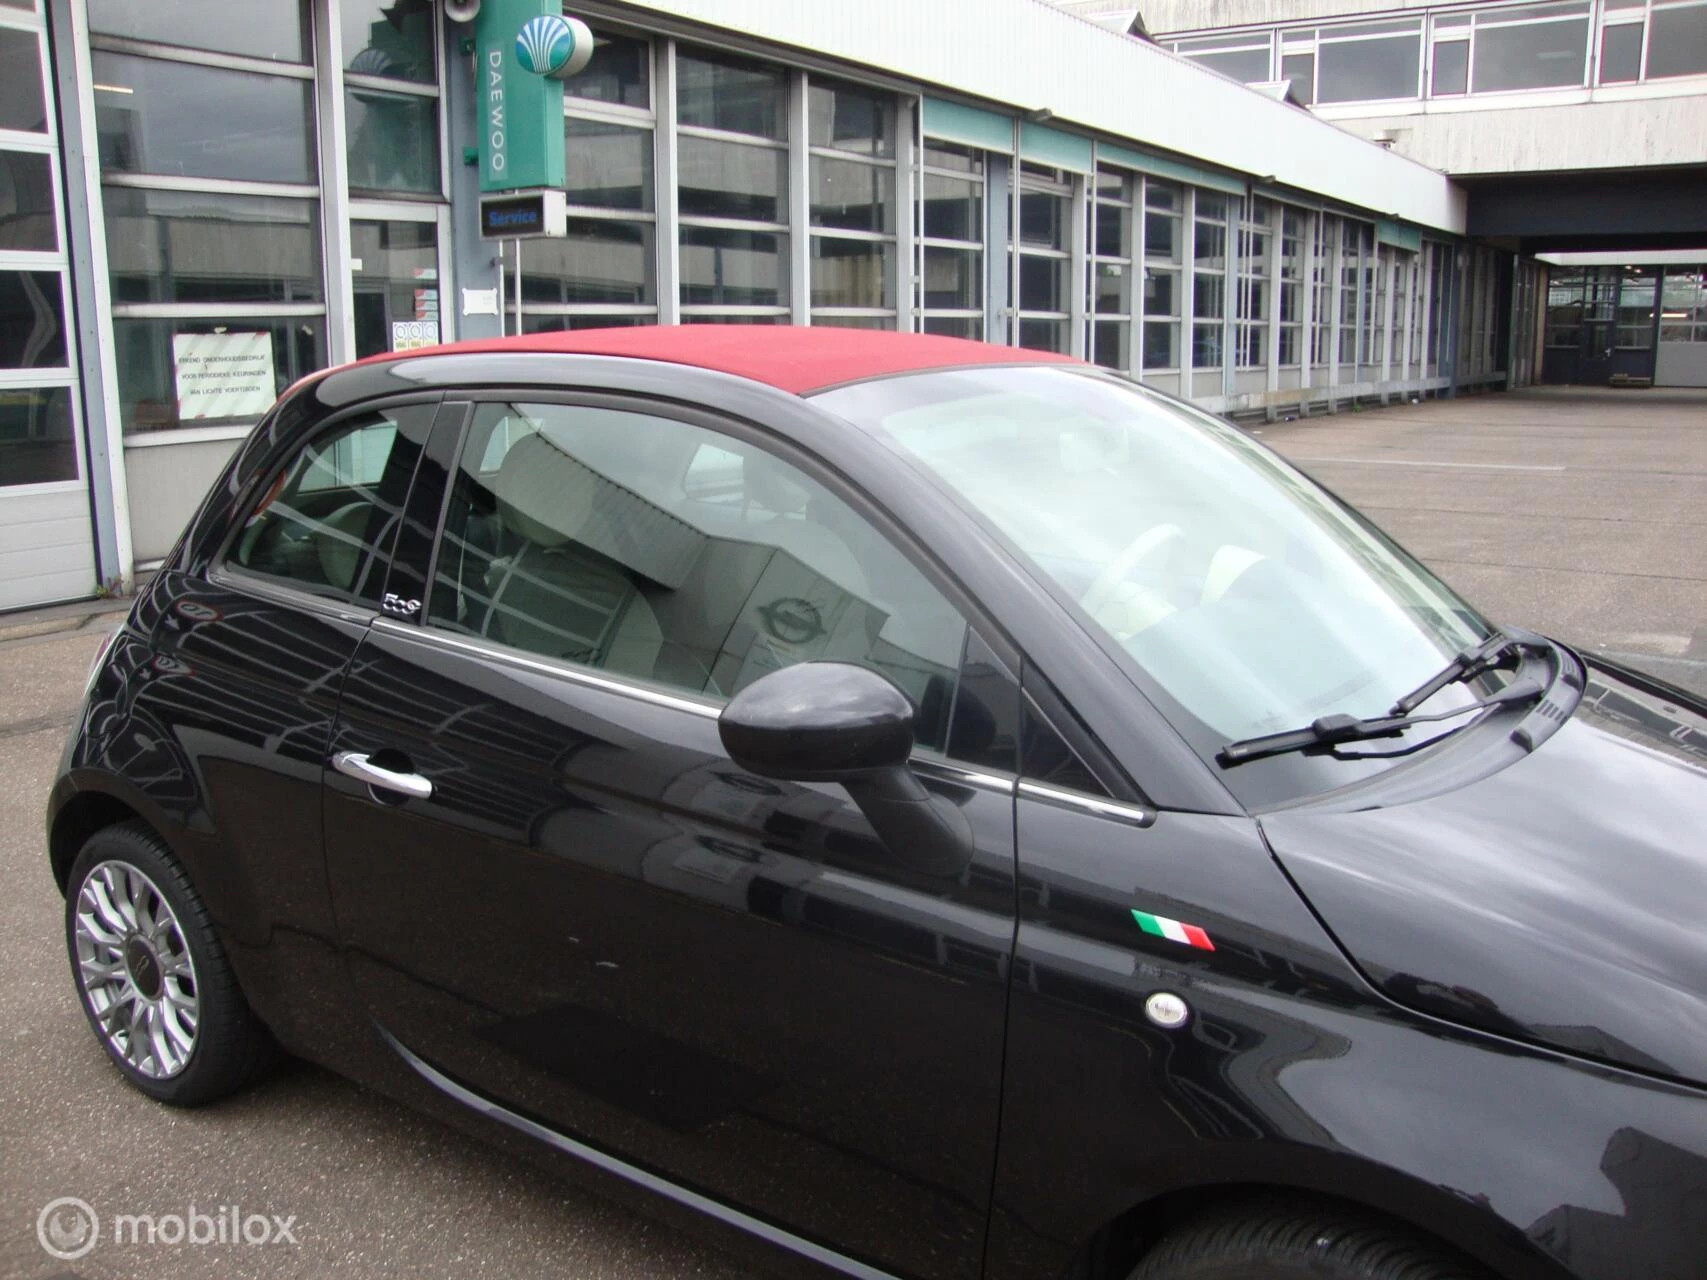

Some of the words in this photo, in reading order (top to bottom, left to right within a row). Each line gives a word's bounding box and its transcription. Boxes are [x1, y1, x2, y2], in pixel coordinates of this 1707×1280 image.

[489, 51, 505, 171] DAEWOO
[489, 210, 537, 226] Service
[202, 387, 222, 395] LICHTE
